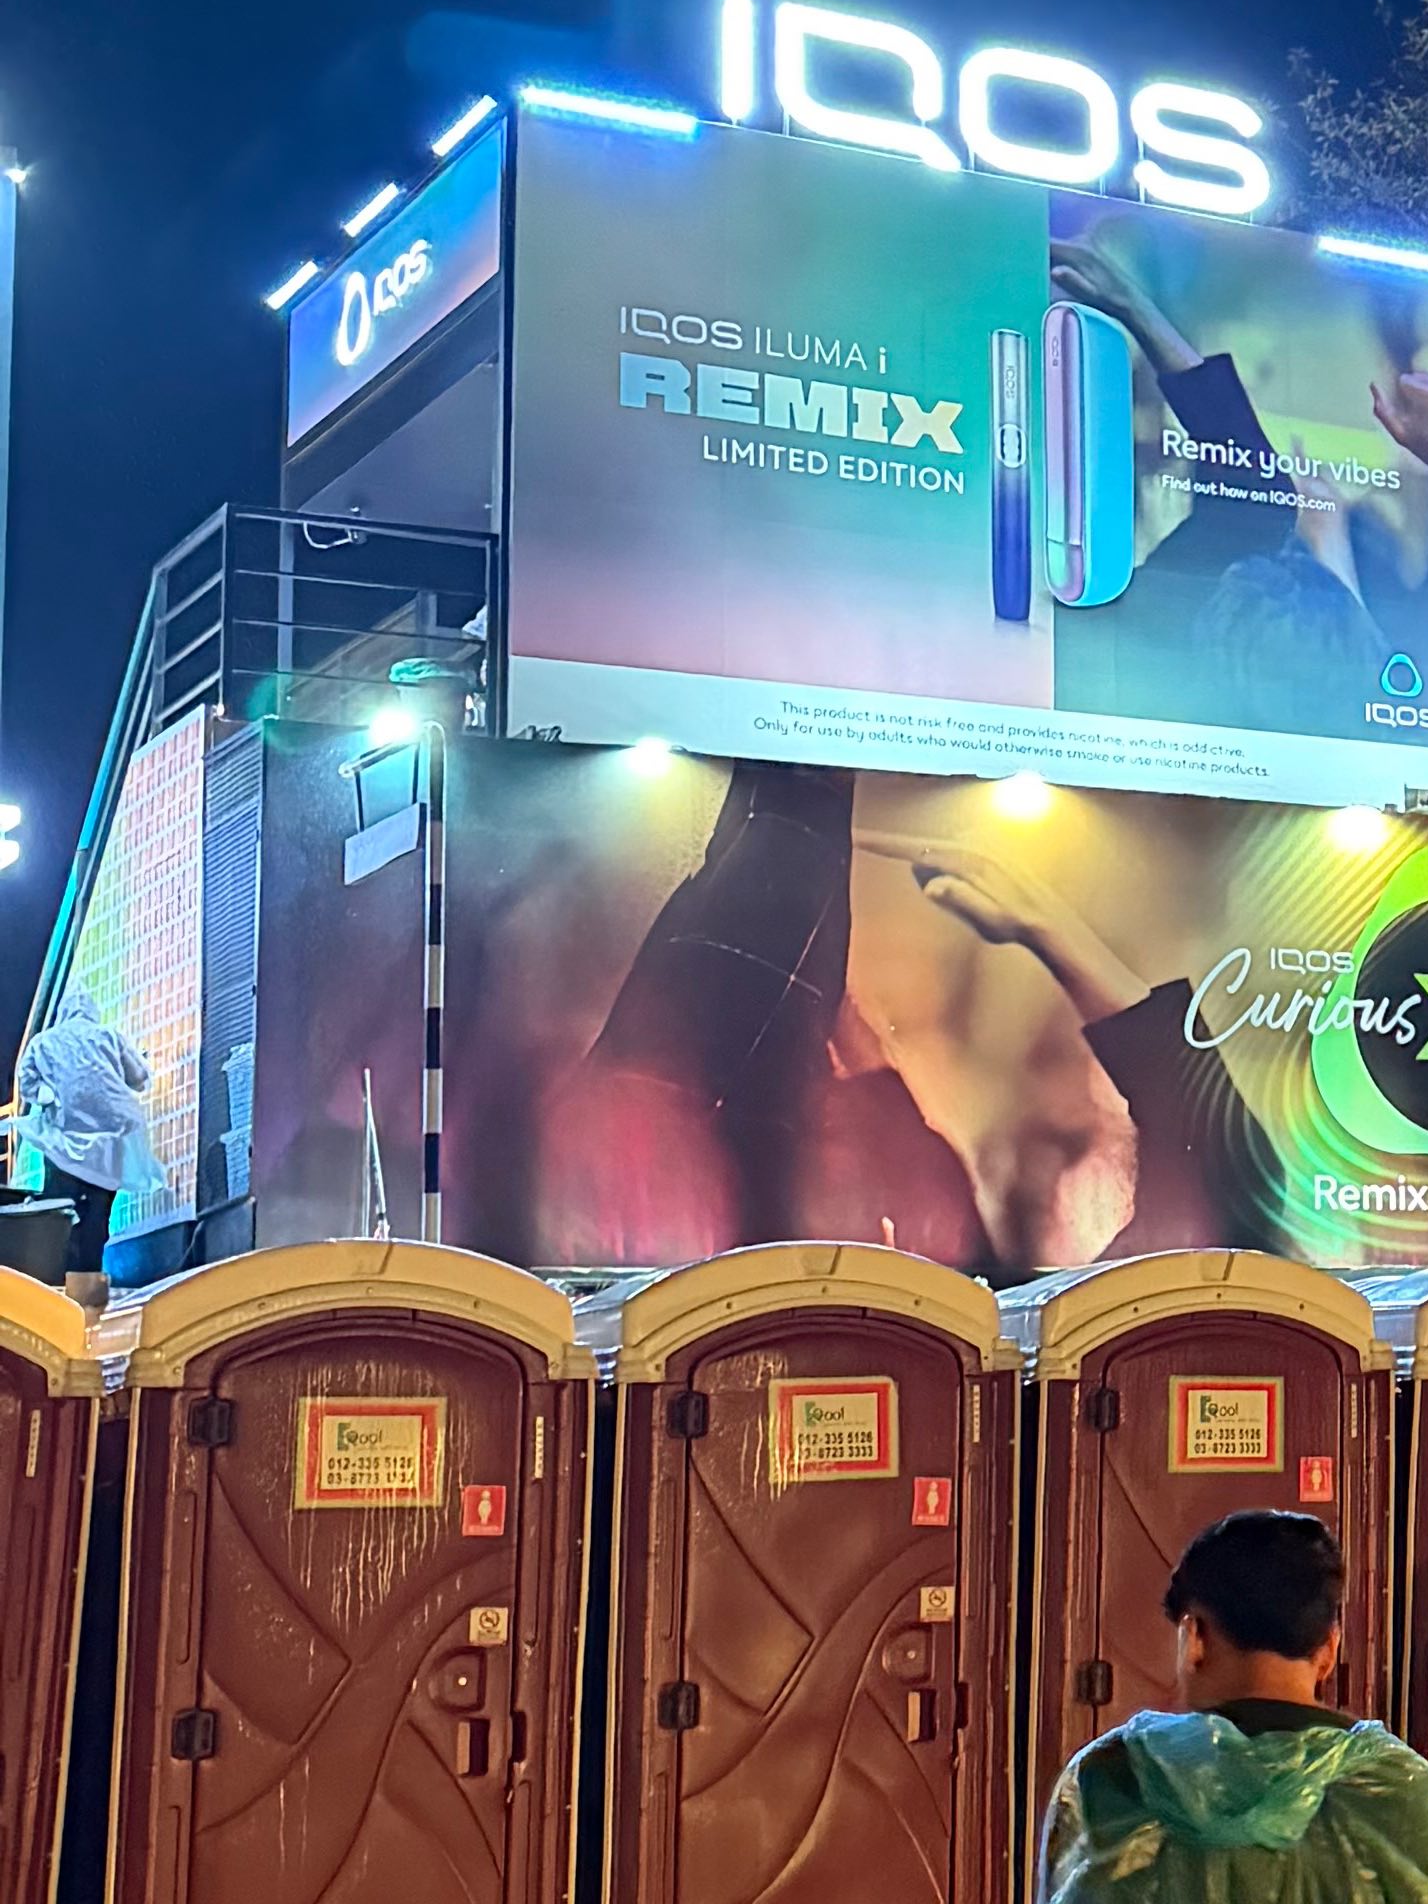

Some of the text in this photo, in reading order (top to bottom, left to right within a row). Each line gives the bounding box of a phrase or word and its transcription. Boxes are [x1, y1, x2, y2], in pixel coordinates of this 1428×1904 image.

[619, 306, 744, 351] IQOS
[756, 326, 868, 372] ILUMA
[619, 351, 964, 455] REMIX
[703, 434, 965, 495] LIMITED EDITION
[1162, 428, 1401, 490] Remix your vibes
[1161, 473, 1336, 513] Find out how on IQOS.com
[753, 717, 788, 736] Only
[793, 720, 814, 734] for
[846, 725, 865, 743] by
[780, 700, 809, 716] This
[814, 707, 870, 723] product
[875, 713, 886, 723] is
[889, 715, 913, 727] not
[978, 721, 1005, 735] and
[1269, 946, 1355, 975] IQOS
[1183, 947, 1422, 1049] Curious
[1313, 1173, 1428, 1212] Remix
